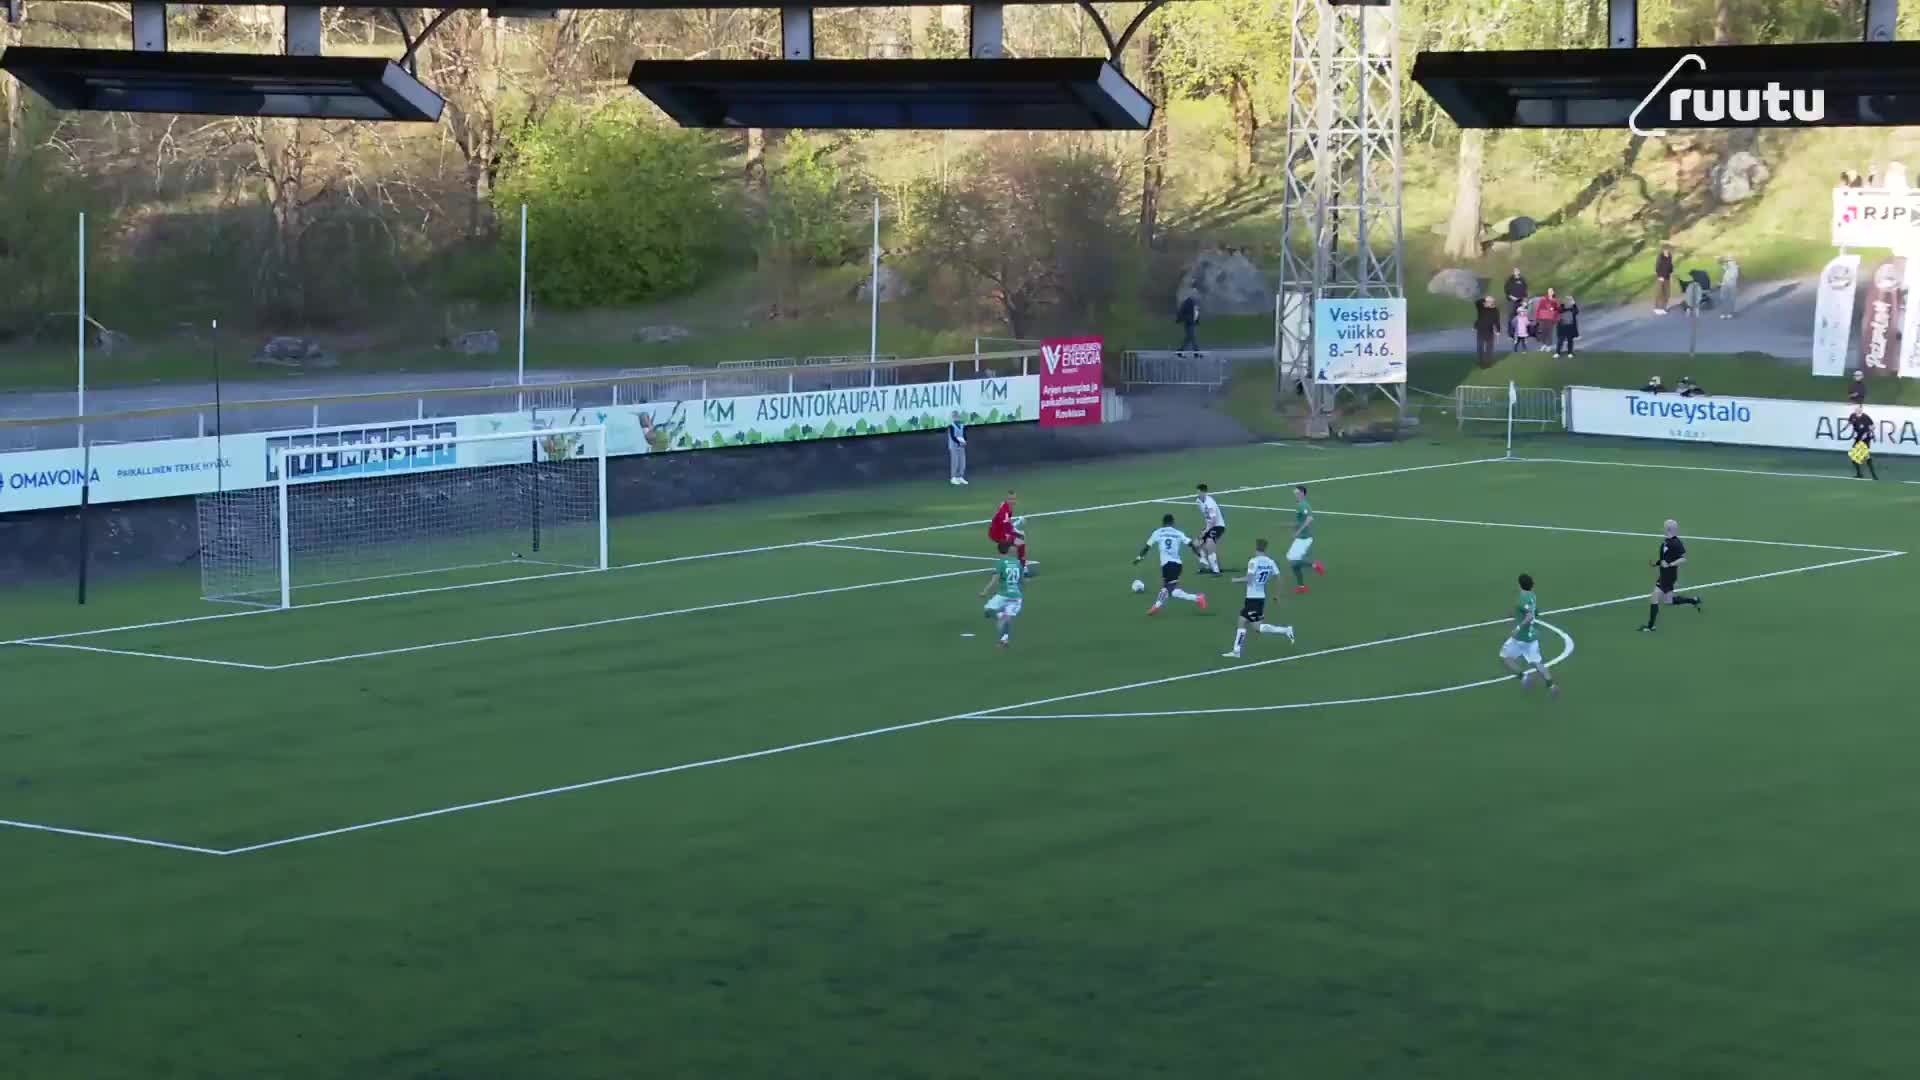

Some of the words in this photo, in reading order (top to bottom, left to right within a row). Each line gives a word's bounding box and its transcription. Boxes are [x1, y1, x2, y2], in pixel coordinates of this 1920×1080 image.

[1864, 206, 1906, 220] RJP
[1329, 306, 1393, 321] Vesistö-
[1337, 324, 1386, 339] viikko
[1062, 350, 1101, 367] ENERGIA
[981, 380, 1008, 400] KM
[757, 389, 888, 421] ASUNTOKAUPAT
[893, 382, 962, 411] MAALIIN
[1626, 396, 1750, 424] Terveystalo
[704, 400, 735, 422] KM
[1165, 538, 1172, 550] 9
